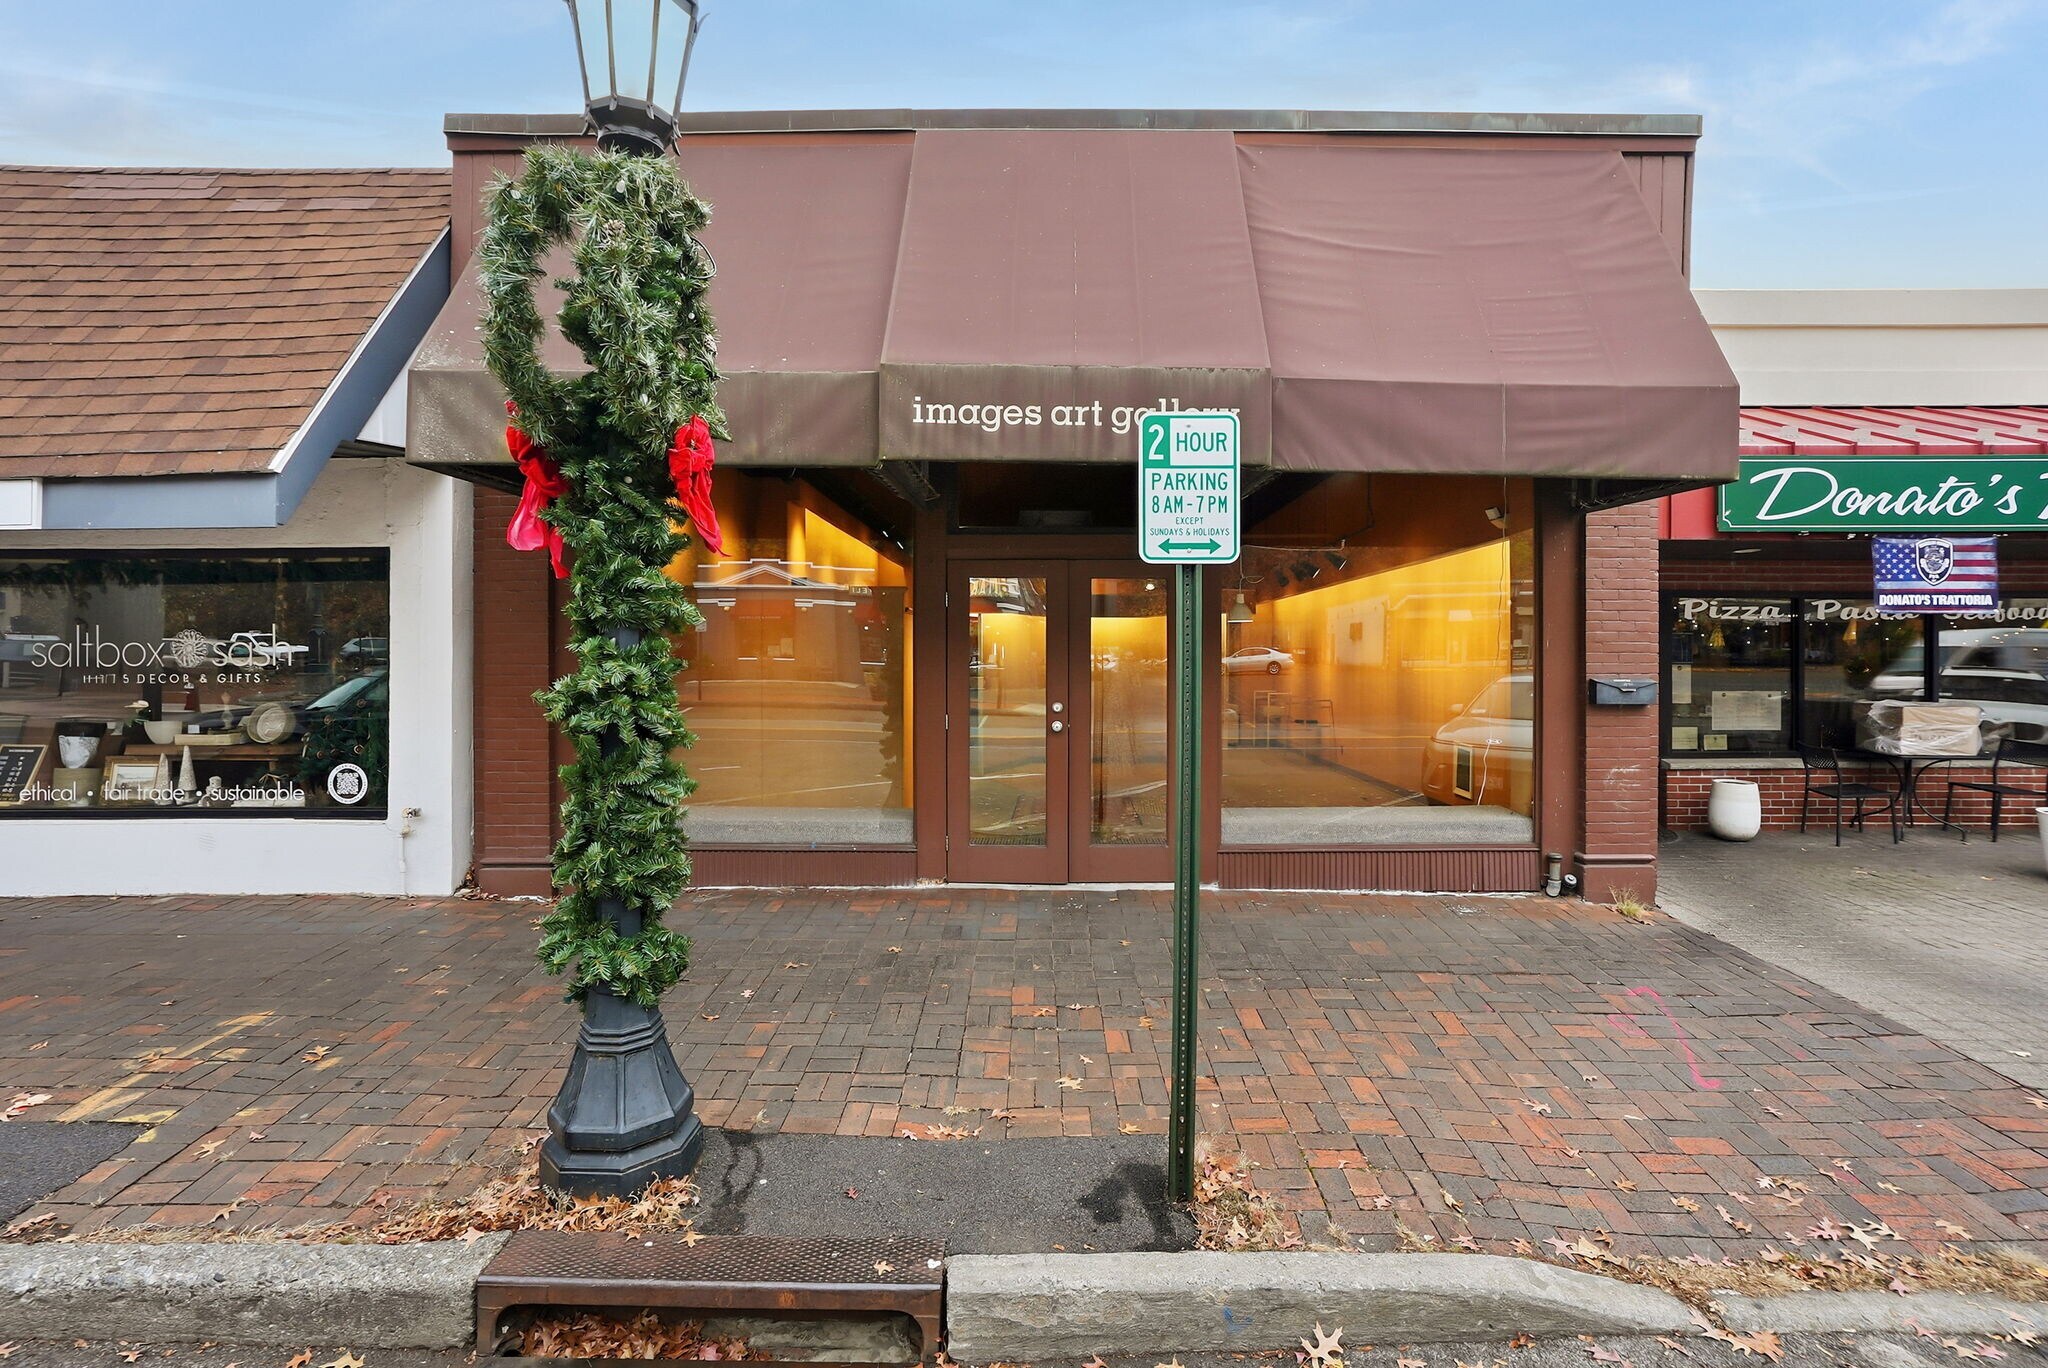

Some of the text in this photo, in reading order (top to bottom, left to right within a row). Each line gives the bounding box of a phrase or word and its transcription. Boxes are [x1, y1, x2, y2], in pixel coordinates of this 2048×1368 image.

[912, 395, 1042, 432] images
[1050, 400, 1103, 426] art
[1148, 423, 1227, 460] 2 HOUR
[1151, 472, 1228, 490] PARKING
[1749, 467, 2024, 521] Donato's
[1175, 516, 1204, 525] EXCEPT
[1149, 527, 1230, 536] SUNDAYS & HOLIDAYS
[1678, 598, 1784, 620] Pizza
[1879, 594, 1993, 606] DONATO'S TRATTORIA
[31, 622, 293, 668] saltbox sash
[199, 673, 208, 684] &
[217, 673, 261, 684] GIFTS
[20, 780, 76, 801] ethical
[104, 780, 132, 801] fair
[137, 780, 185, 801] trade
[210, 780, 305, 801] sustainable
